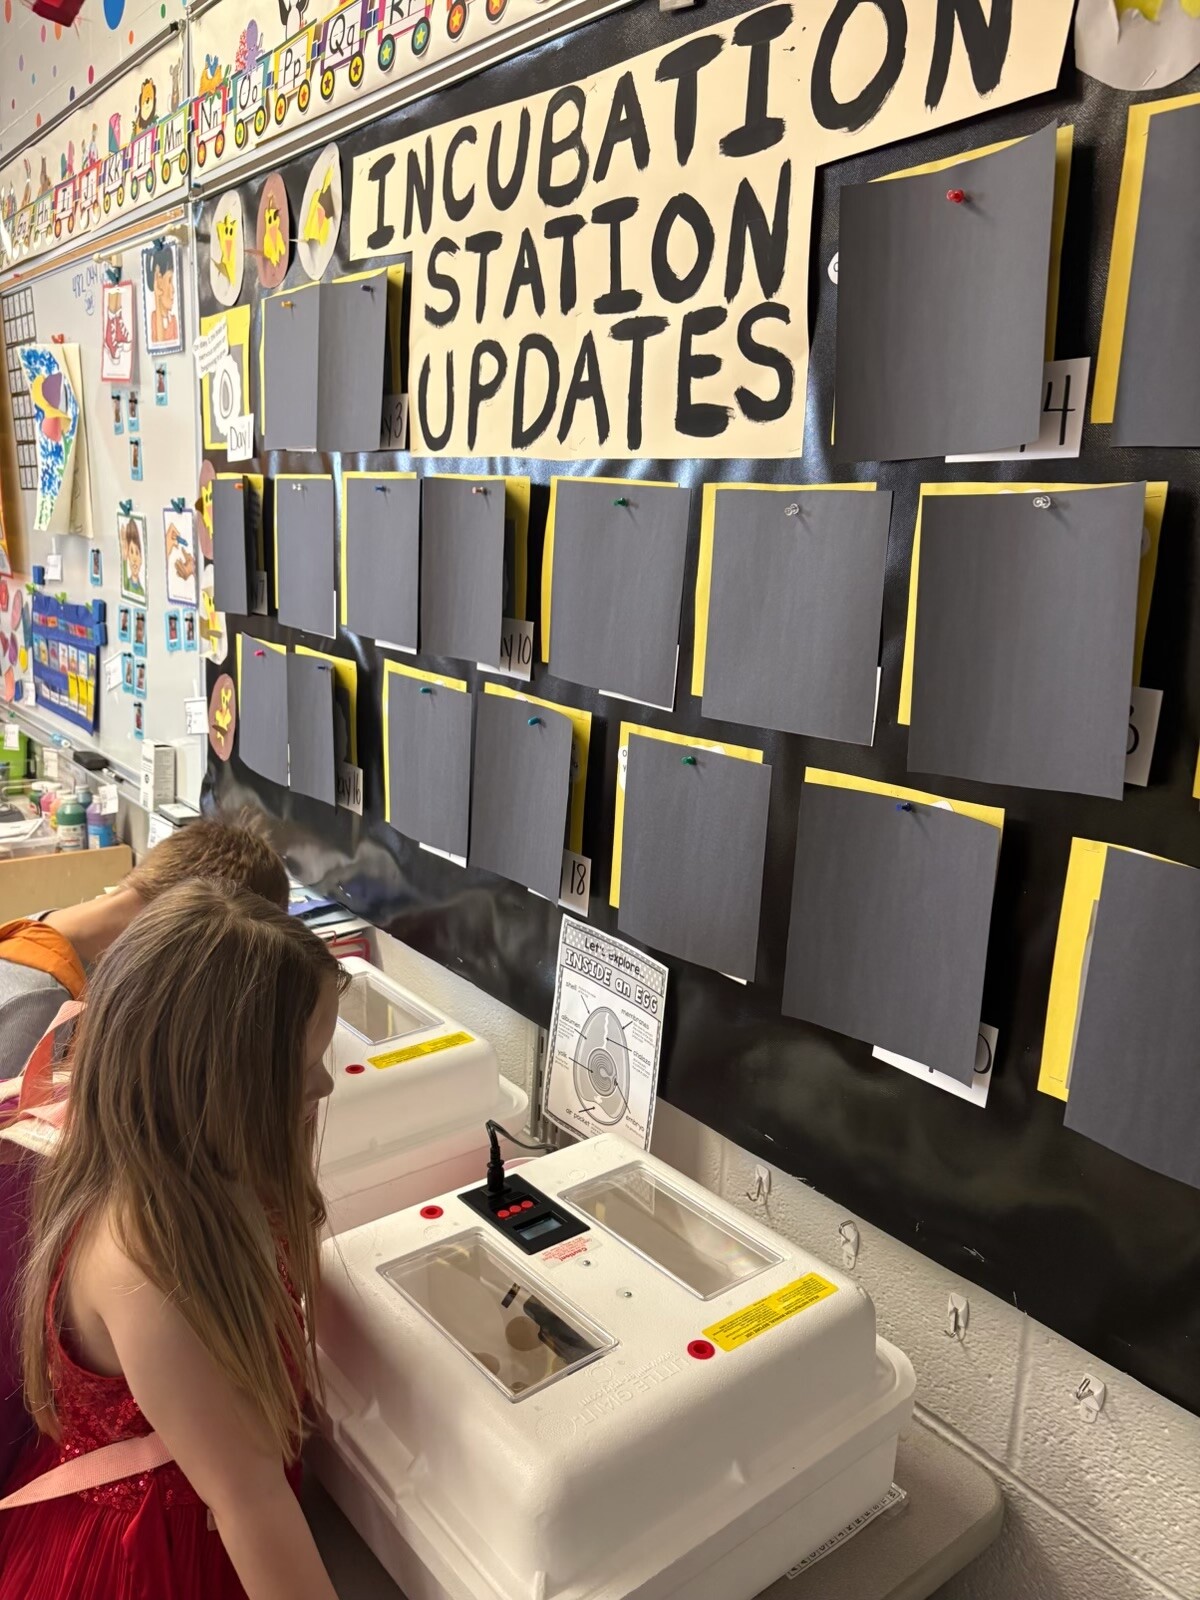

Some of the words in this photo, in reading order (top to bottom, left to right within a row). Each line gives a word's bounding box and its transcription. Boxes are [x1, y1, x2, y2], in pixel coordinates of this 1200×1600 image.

[239, 74, 257, 110] Oo
[283, 47, 301, 88] Pp
[329, 13, 356, 57] Qq
[367, 0, 1013, 249] INCUBATION
[425, 159, 791, 327] STATION
[418, 301, 794, 452] UPDATES
[570, 860, 587, 896] 18
[565, 947, 612, 987] INSIDE
[615, 978, 632, 998] an
[634, 984, 658, 1014] EGG
[584, 937, 605, 957] Let's
